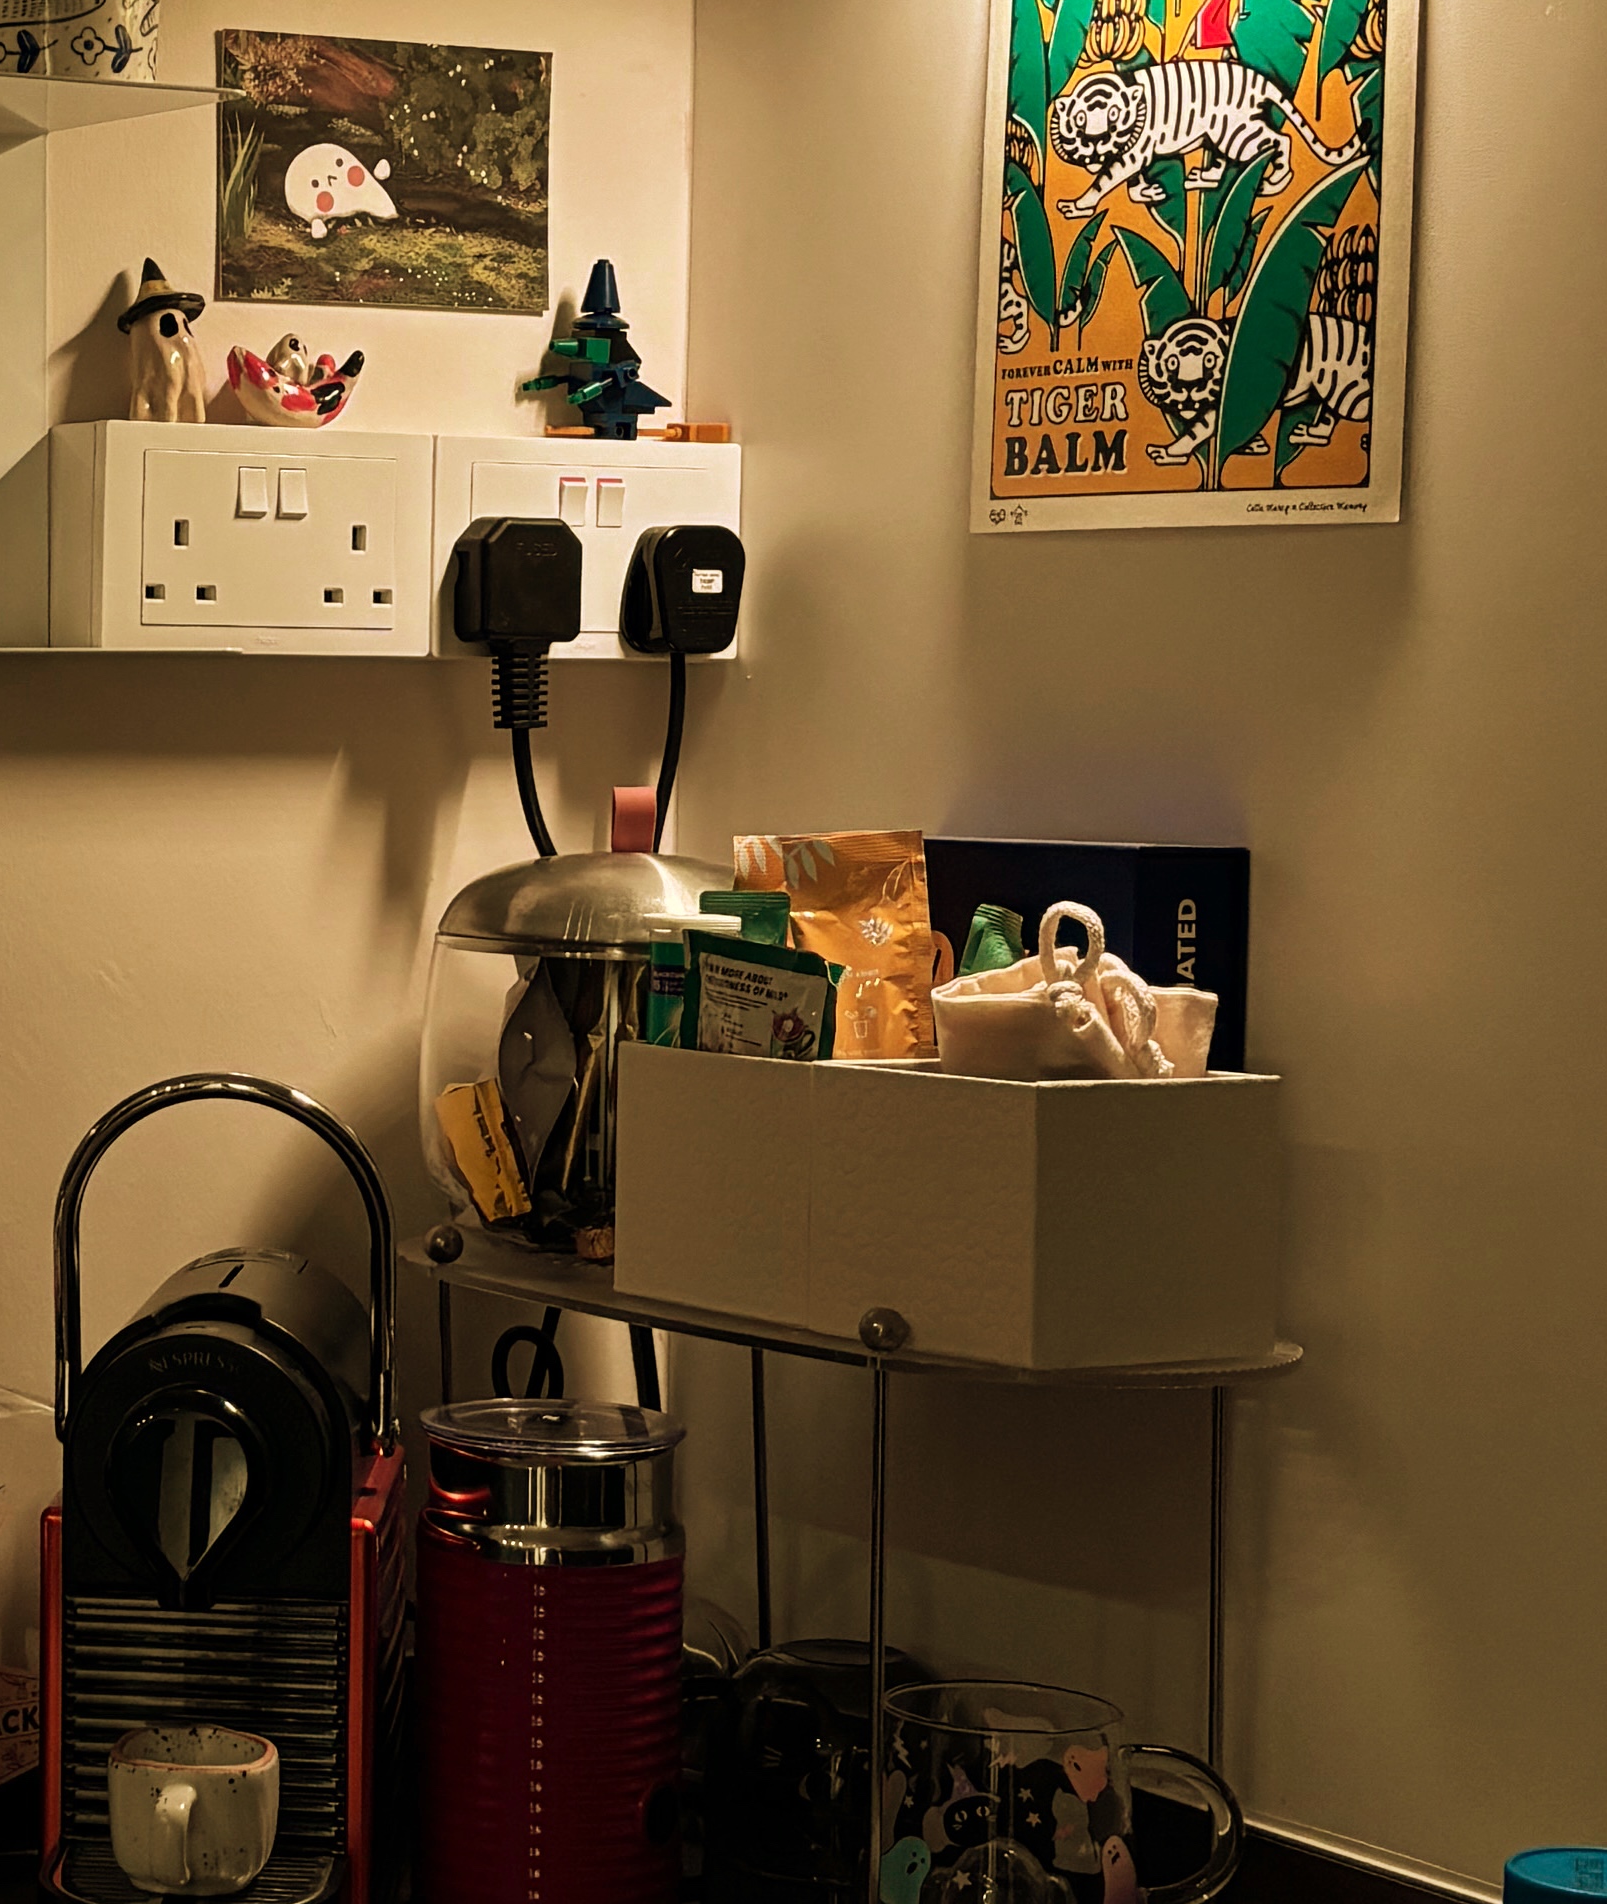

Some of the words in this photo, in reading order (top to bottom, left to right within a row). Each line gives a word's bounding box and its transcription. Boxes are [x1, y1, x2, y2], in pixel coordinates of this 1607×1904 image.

[1001, 365, 1051, 380] FOREVER
[1053, 356, 1100, 376] CALM
[1101, 358, 1134, 372] WITH
[1004, 381, 1130, 427] TIGER
[1004, 429, 1129, 477] BALM
[1175, 897, 1197, 986] ATED
